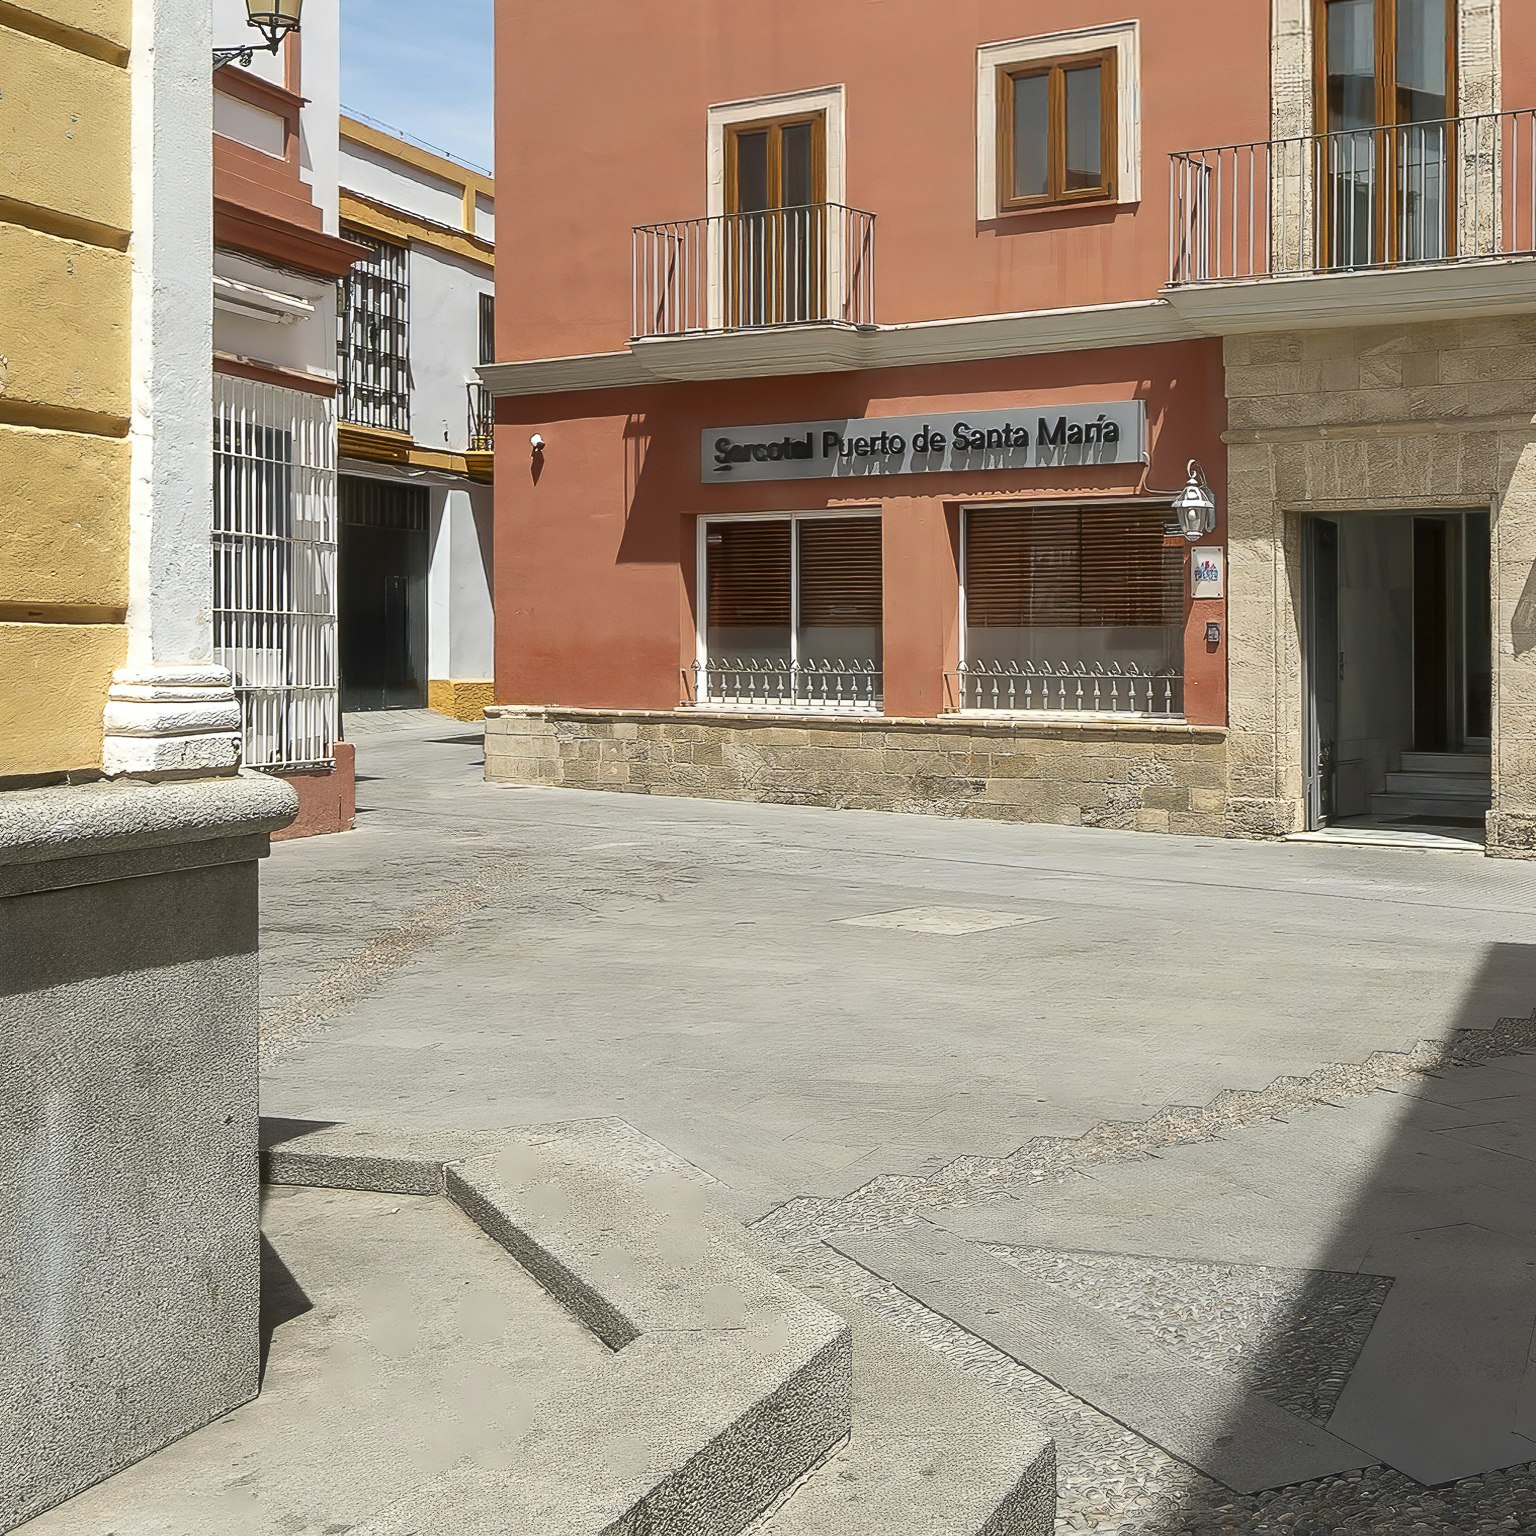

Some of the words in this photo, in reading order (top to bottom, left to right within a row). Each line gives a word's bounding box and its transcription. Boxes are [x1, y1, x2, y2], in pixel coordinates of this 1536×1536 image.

[713, 431, 814, 462] Sercotel
[822, 428, 906, 457] Puerto
[912, 424, 946, 453] de
[952, 421, 1029, 451] Santa
[1036, 414, 1120, 447] María
